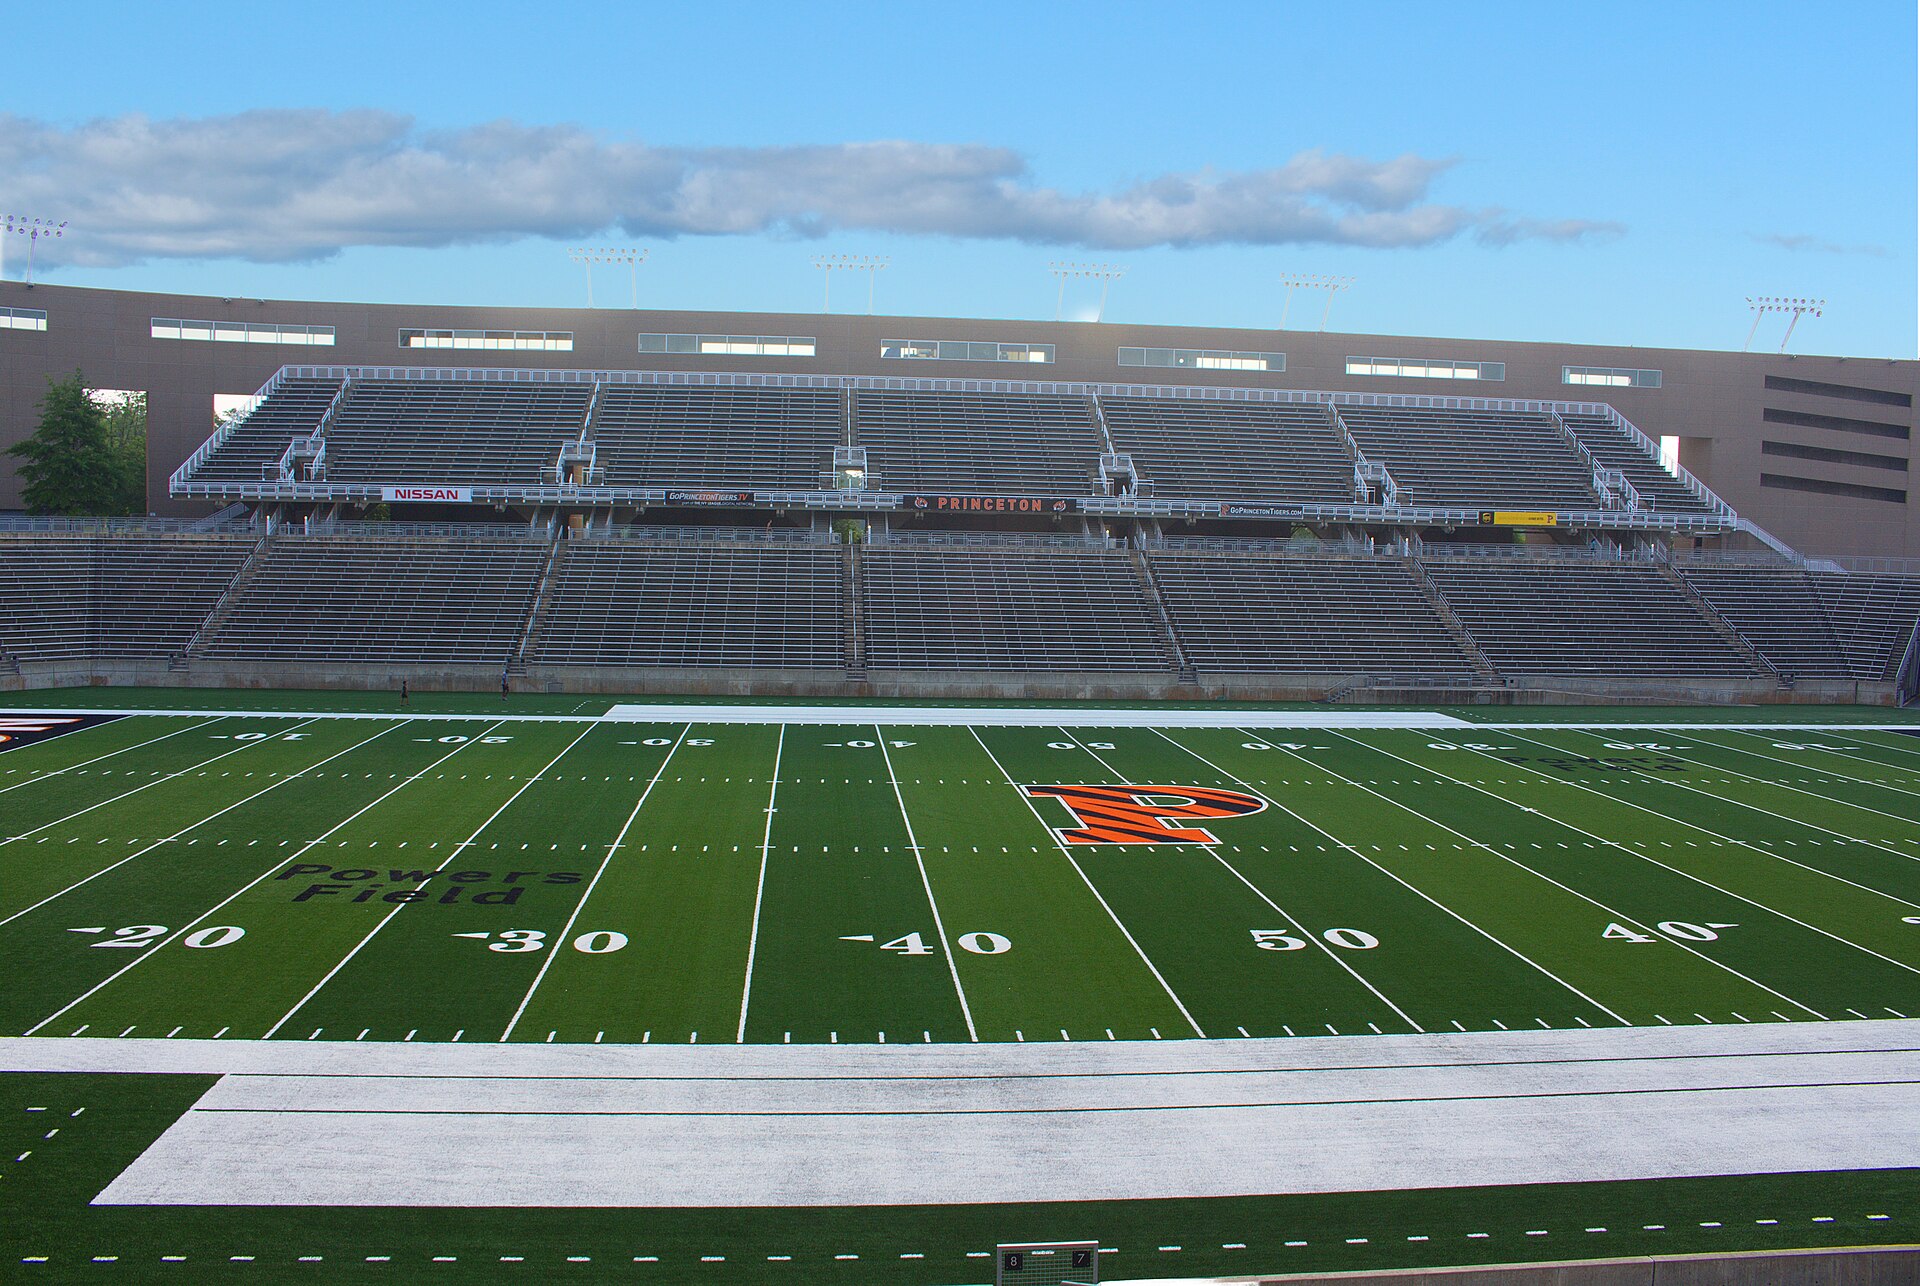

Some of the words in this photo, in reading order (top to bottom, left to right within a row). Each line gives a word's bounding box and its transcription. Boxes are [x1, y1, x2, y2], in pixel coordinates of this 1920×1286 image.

[395, 489, 458, 500] NISSAN
[938, 497, 1042, 511] PRINCETON
[1019, 784, 1269, 845] P
[275, 863, 584, 885] Powers
[291, 884, 526, 905] Field
[90, 924, 246, 949] 20
[487, 929, 630, 954] 30
[880, 931, 1012, 955] 40
[1249, 928, 1380, 950] 50
[1601, 921, 1719, 943] 40
[1010, 1256, 1018, 1266] 8
[1077, 1253, 1085, 1264] 7
